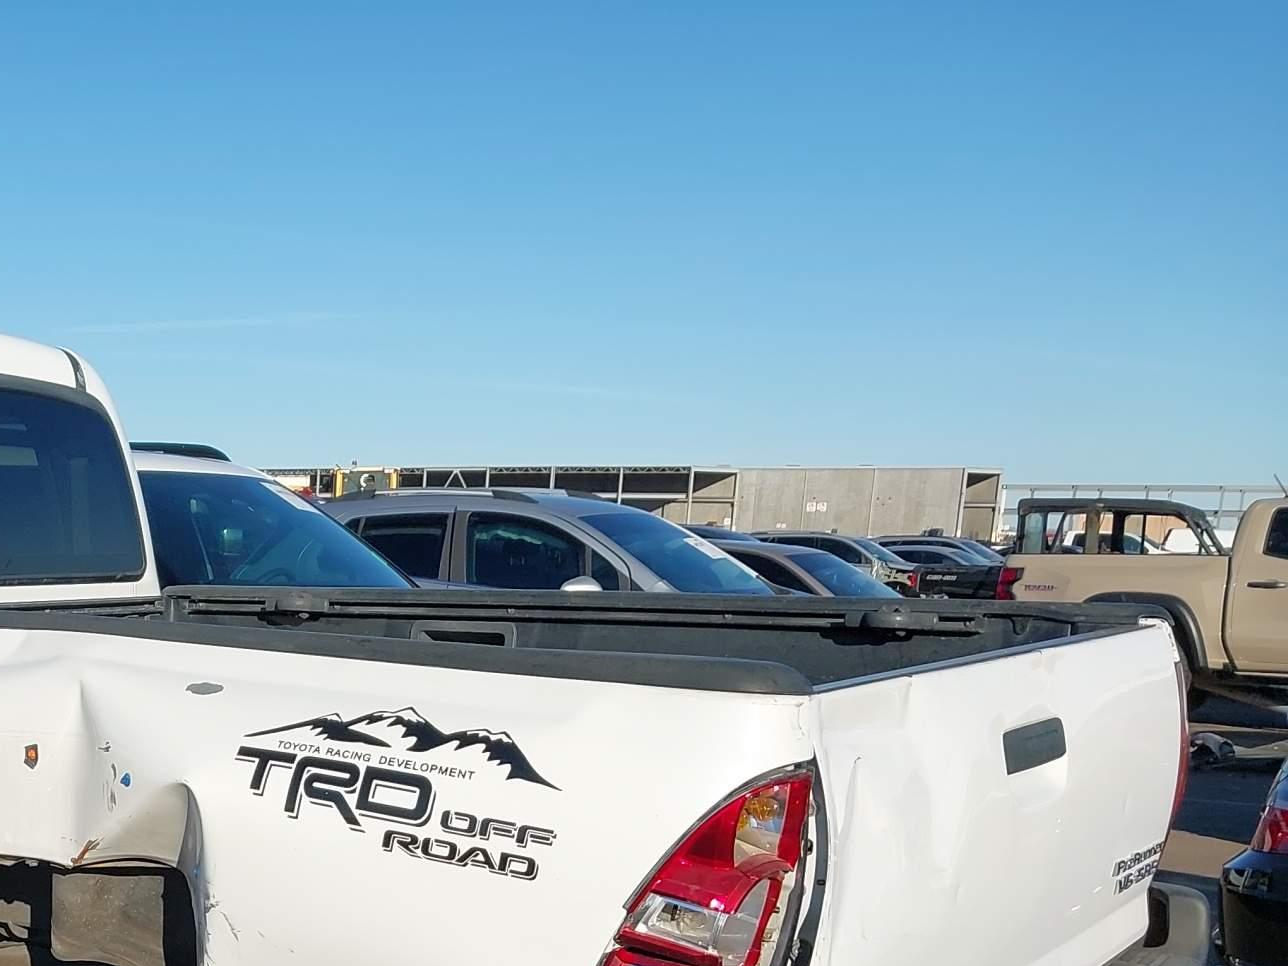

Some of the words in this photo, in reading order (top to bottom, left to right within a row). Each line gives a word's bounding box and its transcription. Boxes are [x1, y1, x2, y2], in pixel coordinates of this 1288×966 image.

[277, 740, 321, 754] TOYOTA
[325, 747, 371, 762] RACING
[378, 756, 476, 780] DEVELOPMENT
[235, 745, 436, 833] TRD
[440, 810, 557, 847] OFF
[381, 830, 539, 881] ROAD
